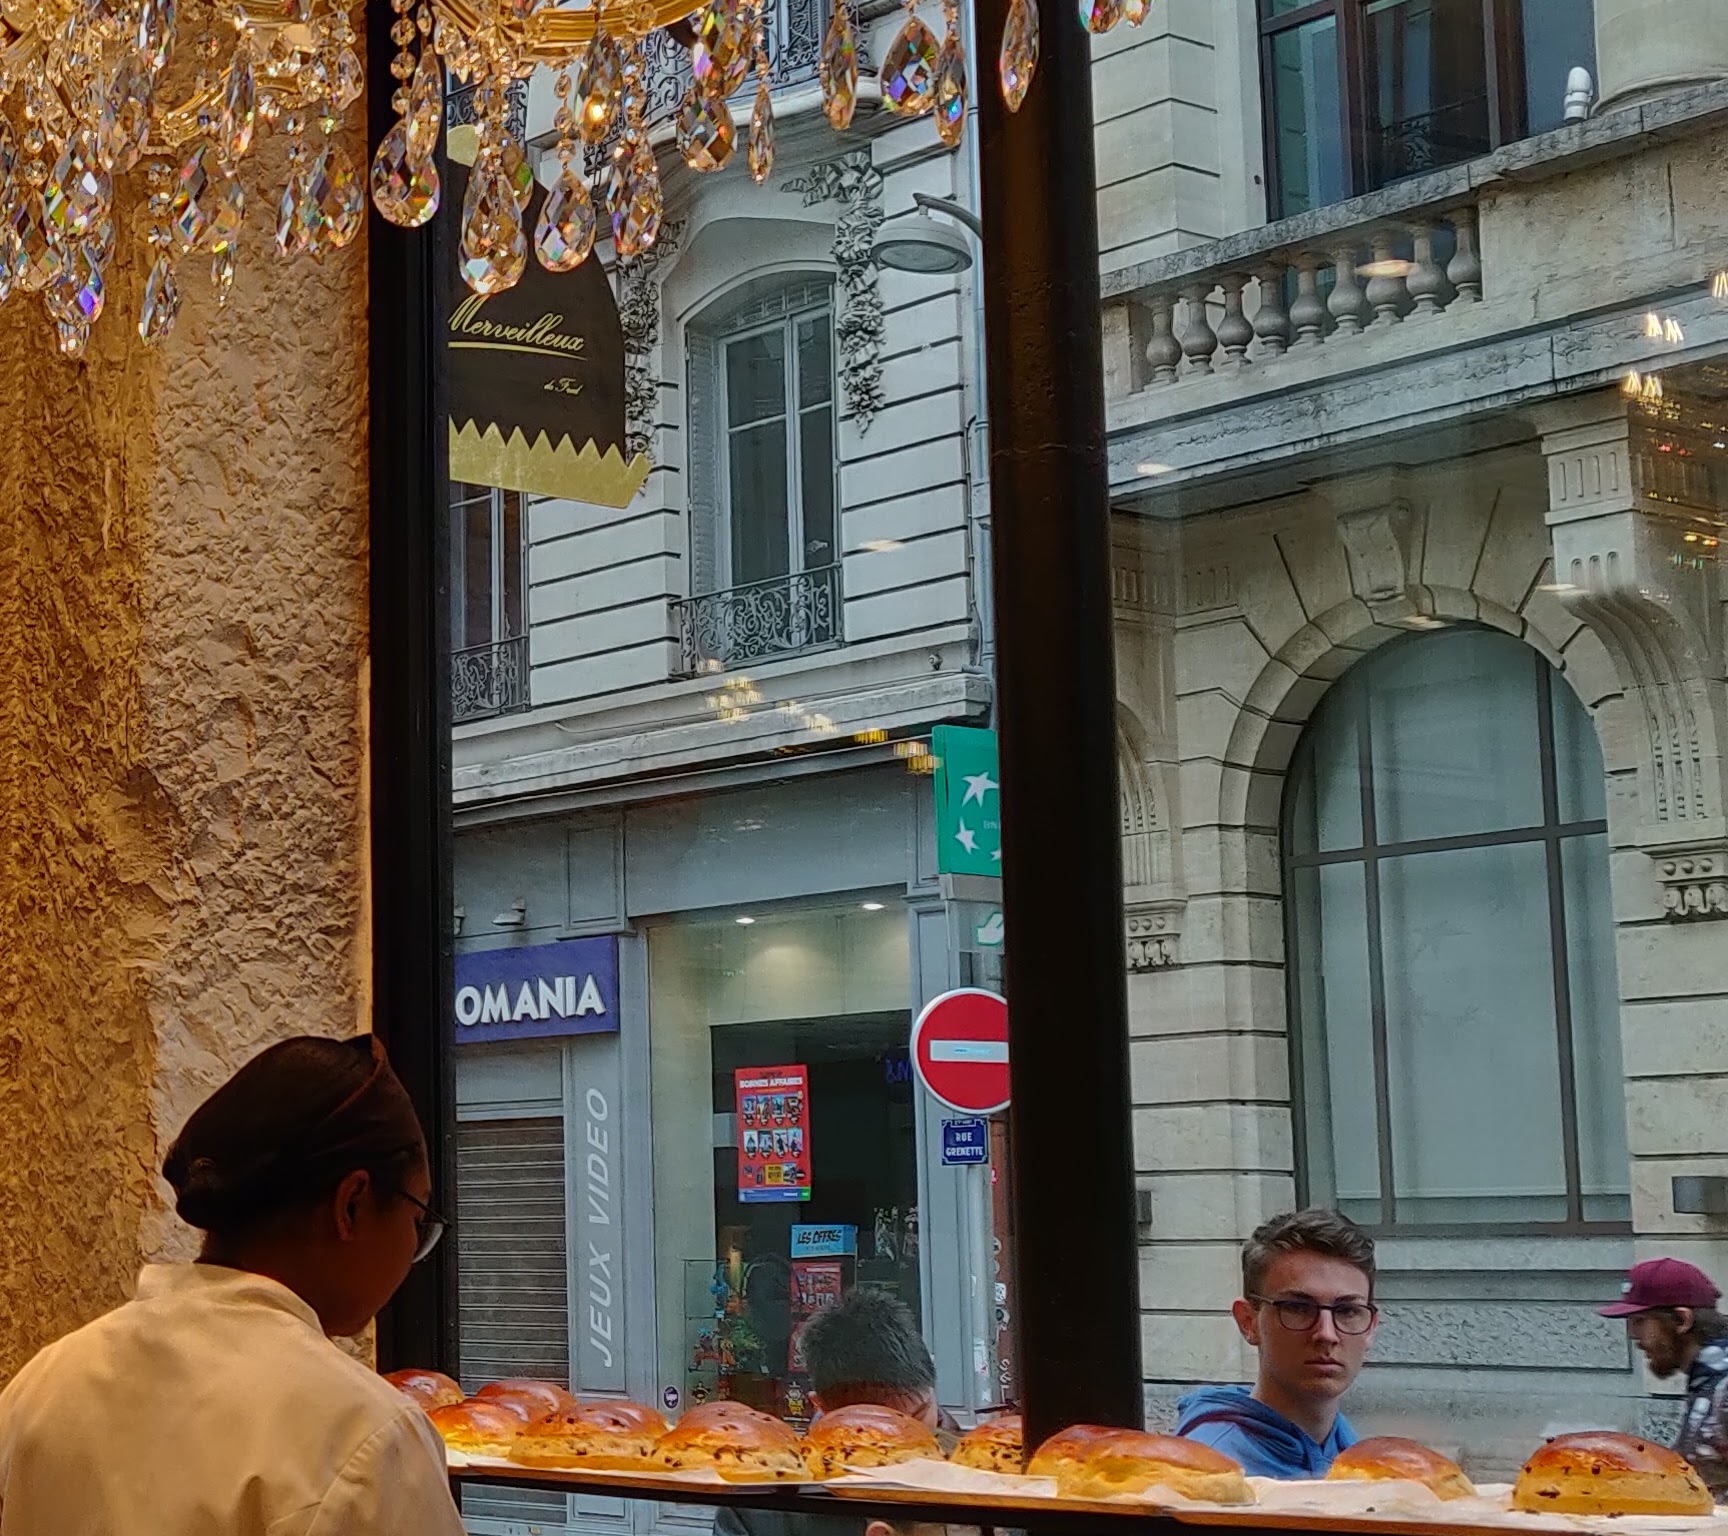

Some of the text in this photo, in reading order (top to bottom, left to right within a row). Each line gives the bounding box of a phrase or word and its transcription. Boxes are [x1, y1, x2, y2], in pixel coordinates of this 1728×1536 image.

[447, 293, 585, 351] Merveilleux
[455, 973, 607, 1026] OMANIA
[955, 1132, 973, 1142] RUE
[586, 1087, 612, 1368] JEUX VIDEO
